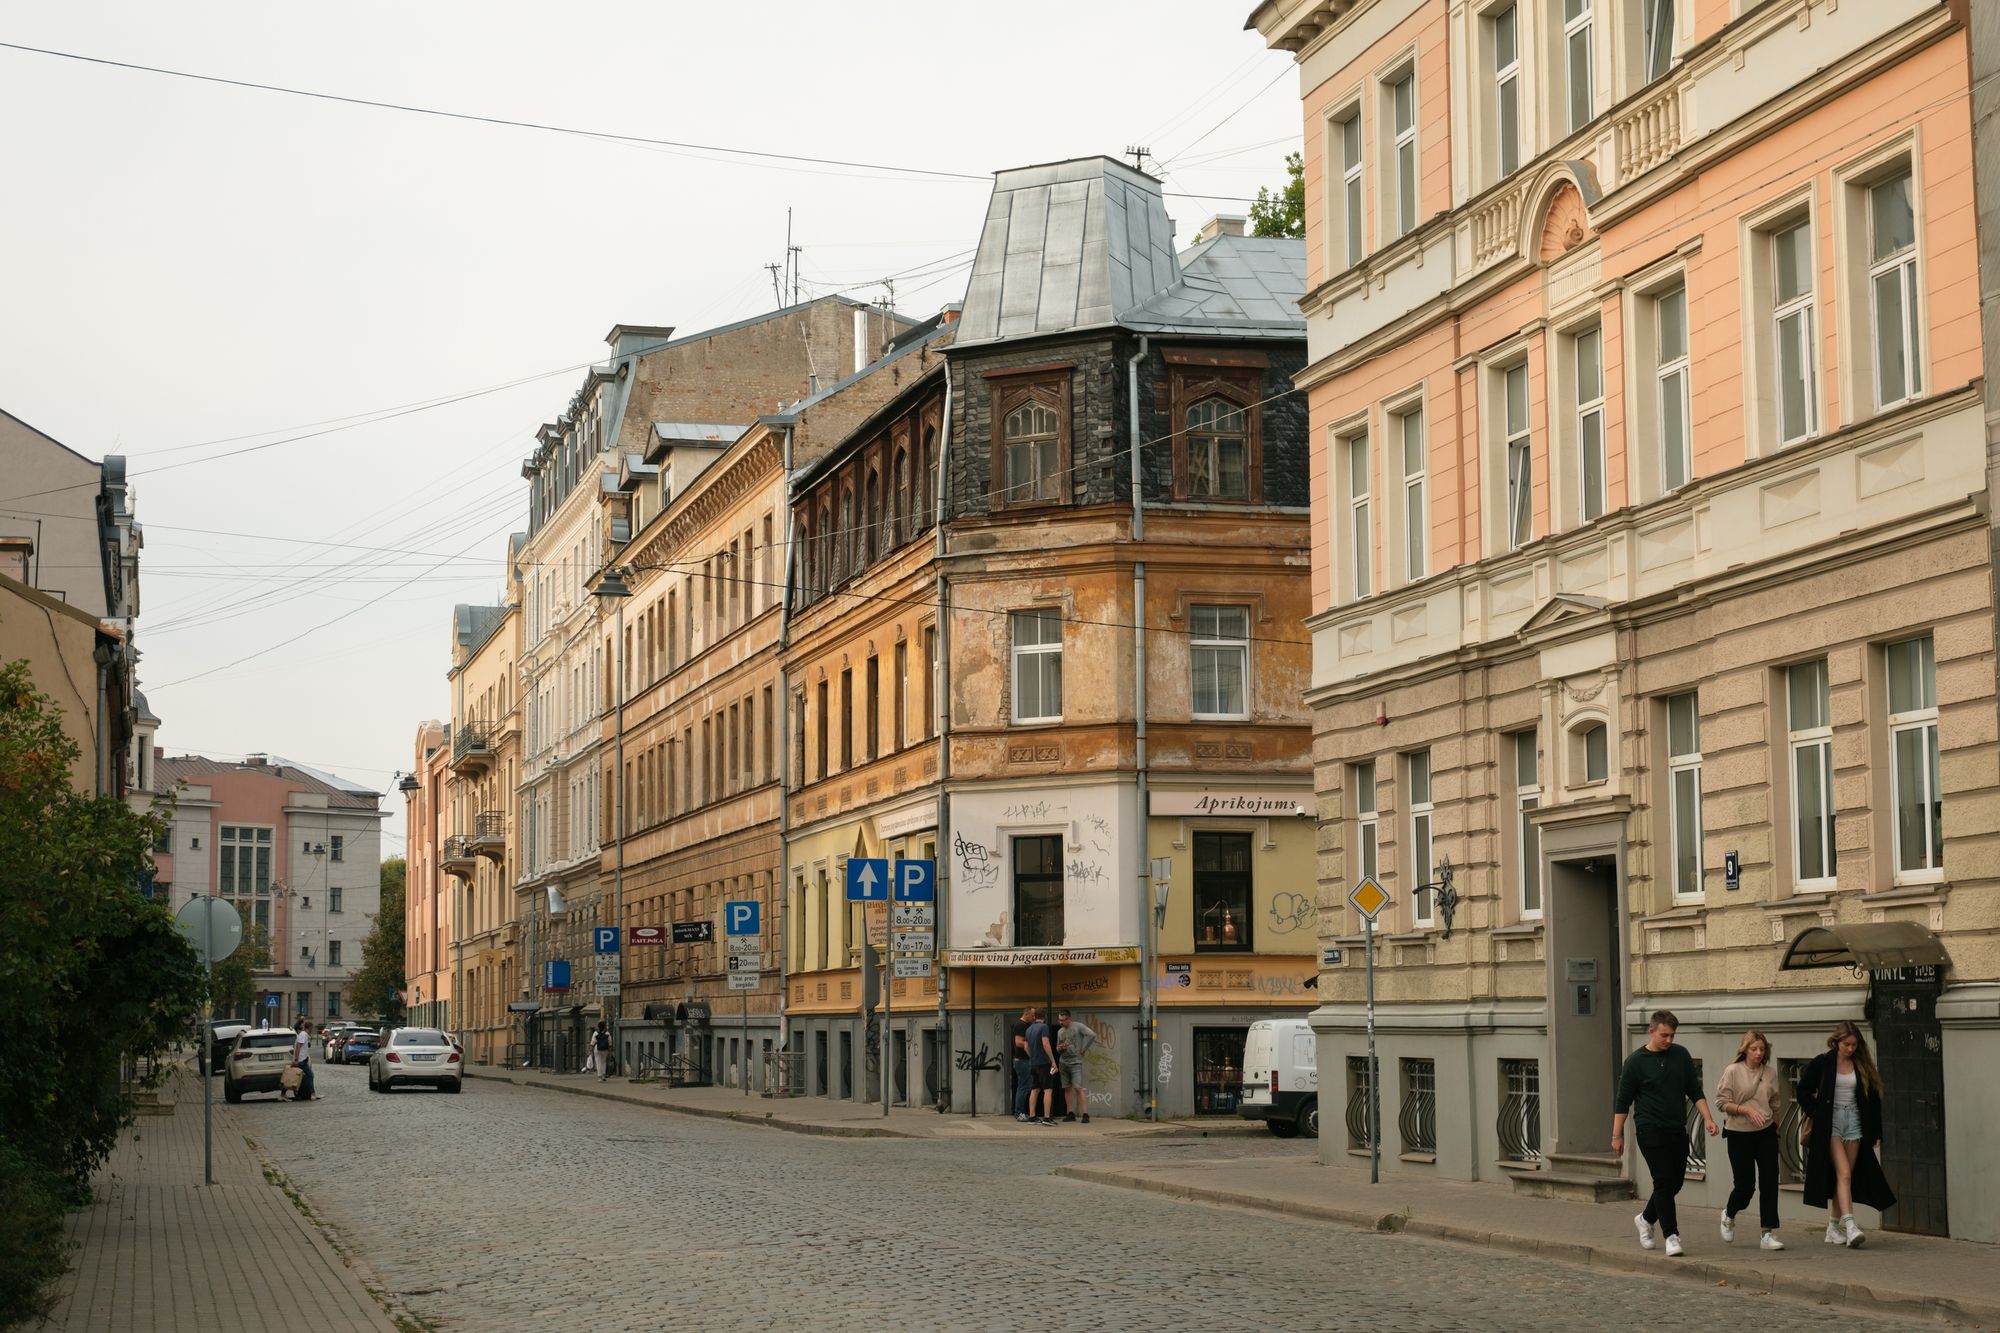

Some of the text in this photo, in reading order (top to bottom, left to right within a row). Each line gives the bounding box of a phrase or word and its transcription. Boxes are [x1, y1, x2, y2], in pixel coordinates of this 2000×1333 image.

[1194, 796, 1296, 813] Aprīkojums
[1727, 861, 1733, 876] 9
[904, 865, 925, 896] P
[734, 905, 751, 931] P
[600, 930, 614, 950] P
[973, 954, 984, 962] un
[987, 953, 1009, 962] vīna
[1010, 949, 1097, 964] pagatavošanai
[922, 963, 929, 971] B
[1873, 967, 1906, 981] VINYL
